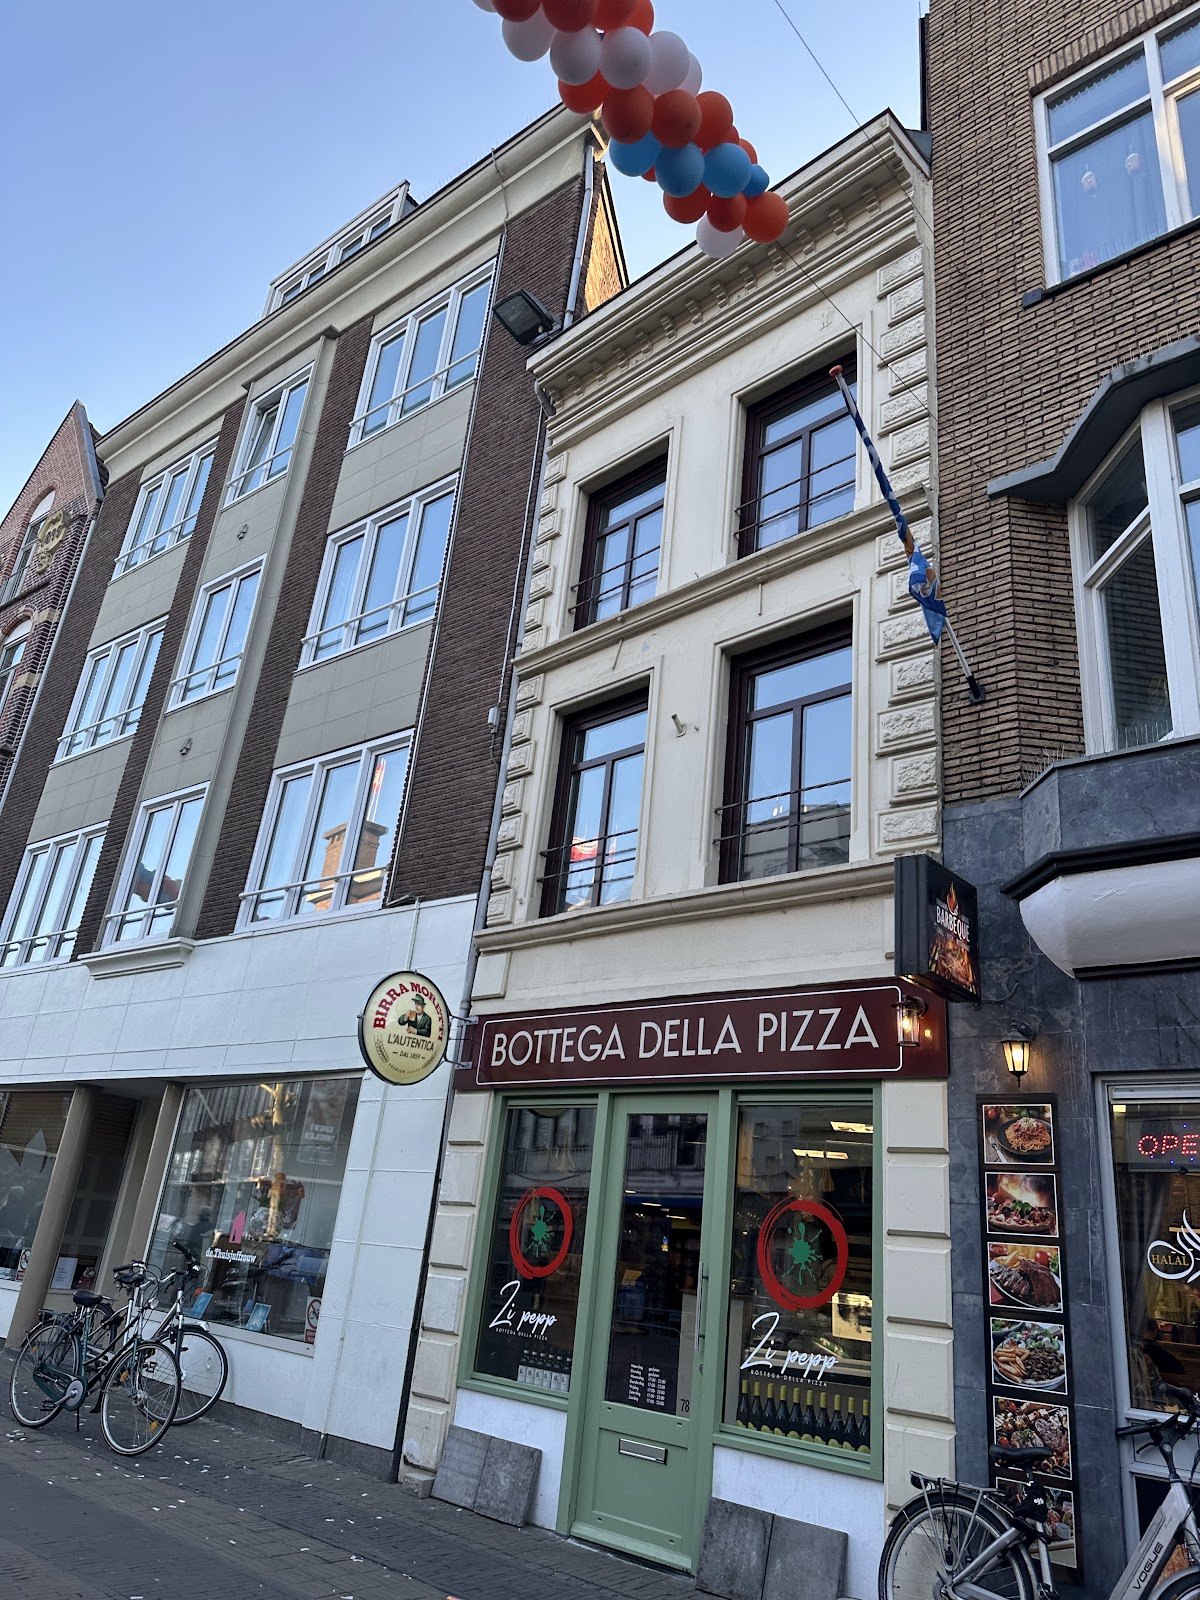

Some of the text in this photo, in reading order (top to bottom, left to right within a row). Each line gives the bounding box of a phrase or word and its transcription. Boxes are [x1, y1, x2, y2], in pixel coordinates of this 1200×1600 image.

[936, 905, 970, 942] BARBEQUE
[373, 981, 444, 1042] BIRRA MORETTI
[387, 1033, 434, 1052] L'AUTENTICA
[490, 1004, 880, 1067] BOTTEGA DELLA PIZZA
[1137, 1133, 1200, 1156] OPE
[1151, 1254, 1190, 1266] HALAL
[495, 1327, 516, 1336] BOTTEGA
[517, 1330, 532, 1338] DELLA
[516, 1310, 558, 1336] pepp
[780, 1349, 839, 1381] pepp
[750, 1369, 828, 1388] BOTTEGA DELLA PIZZA
[680, 1398, 690, 1413] 78
[1133, 1541, 1164, 1590] VOGUE
